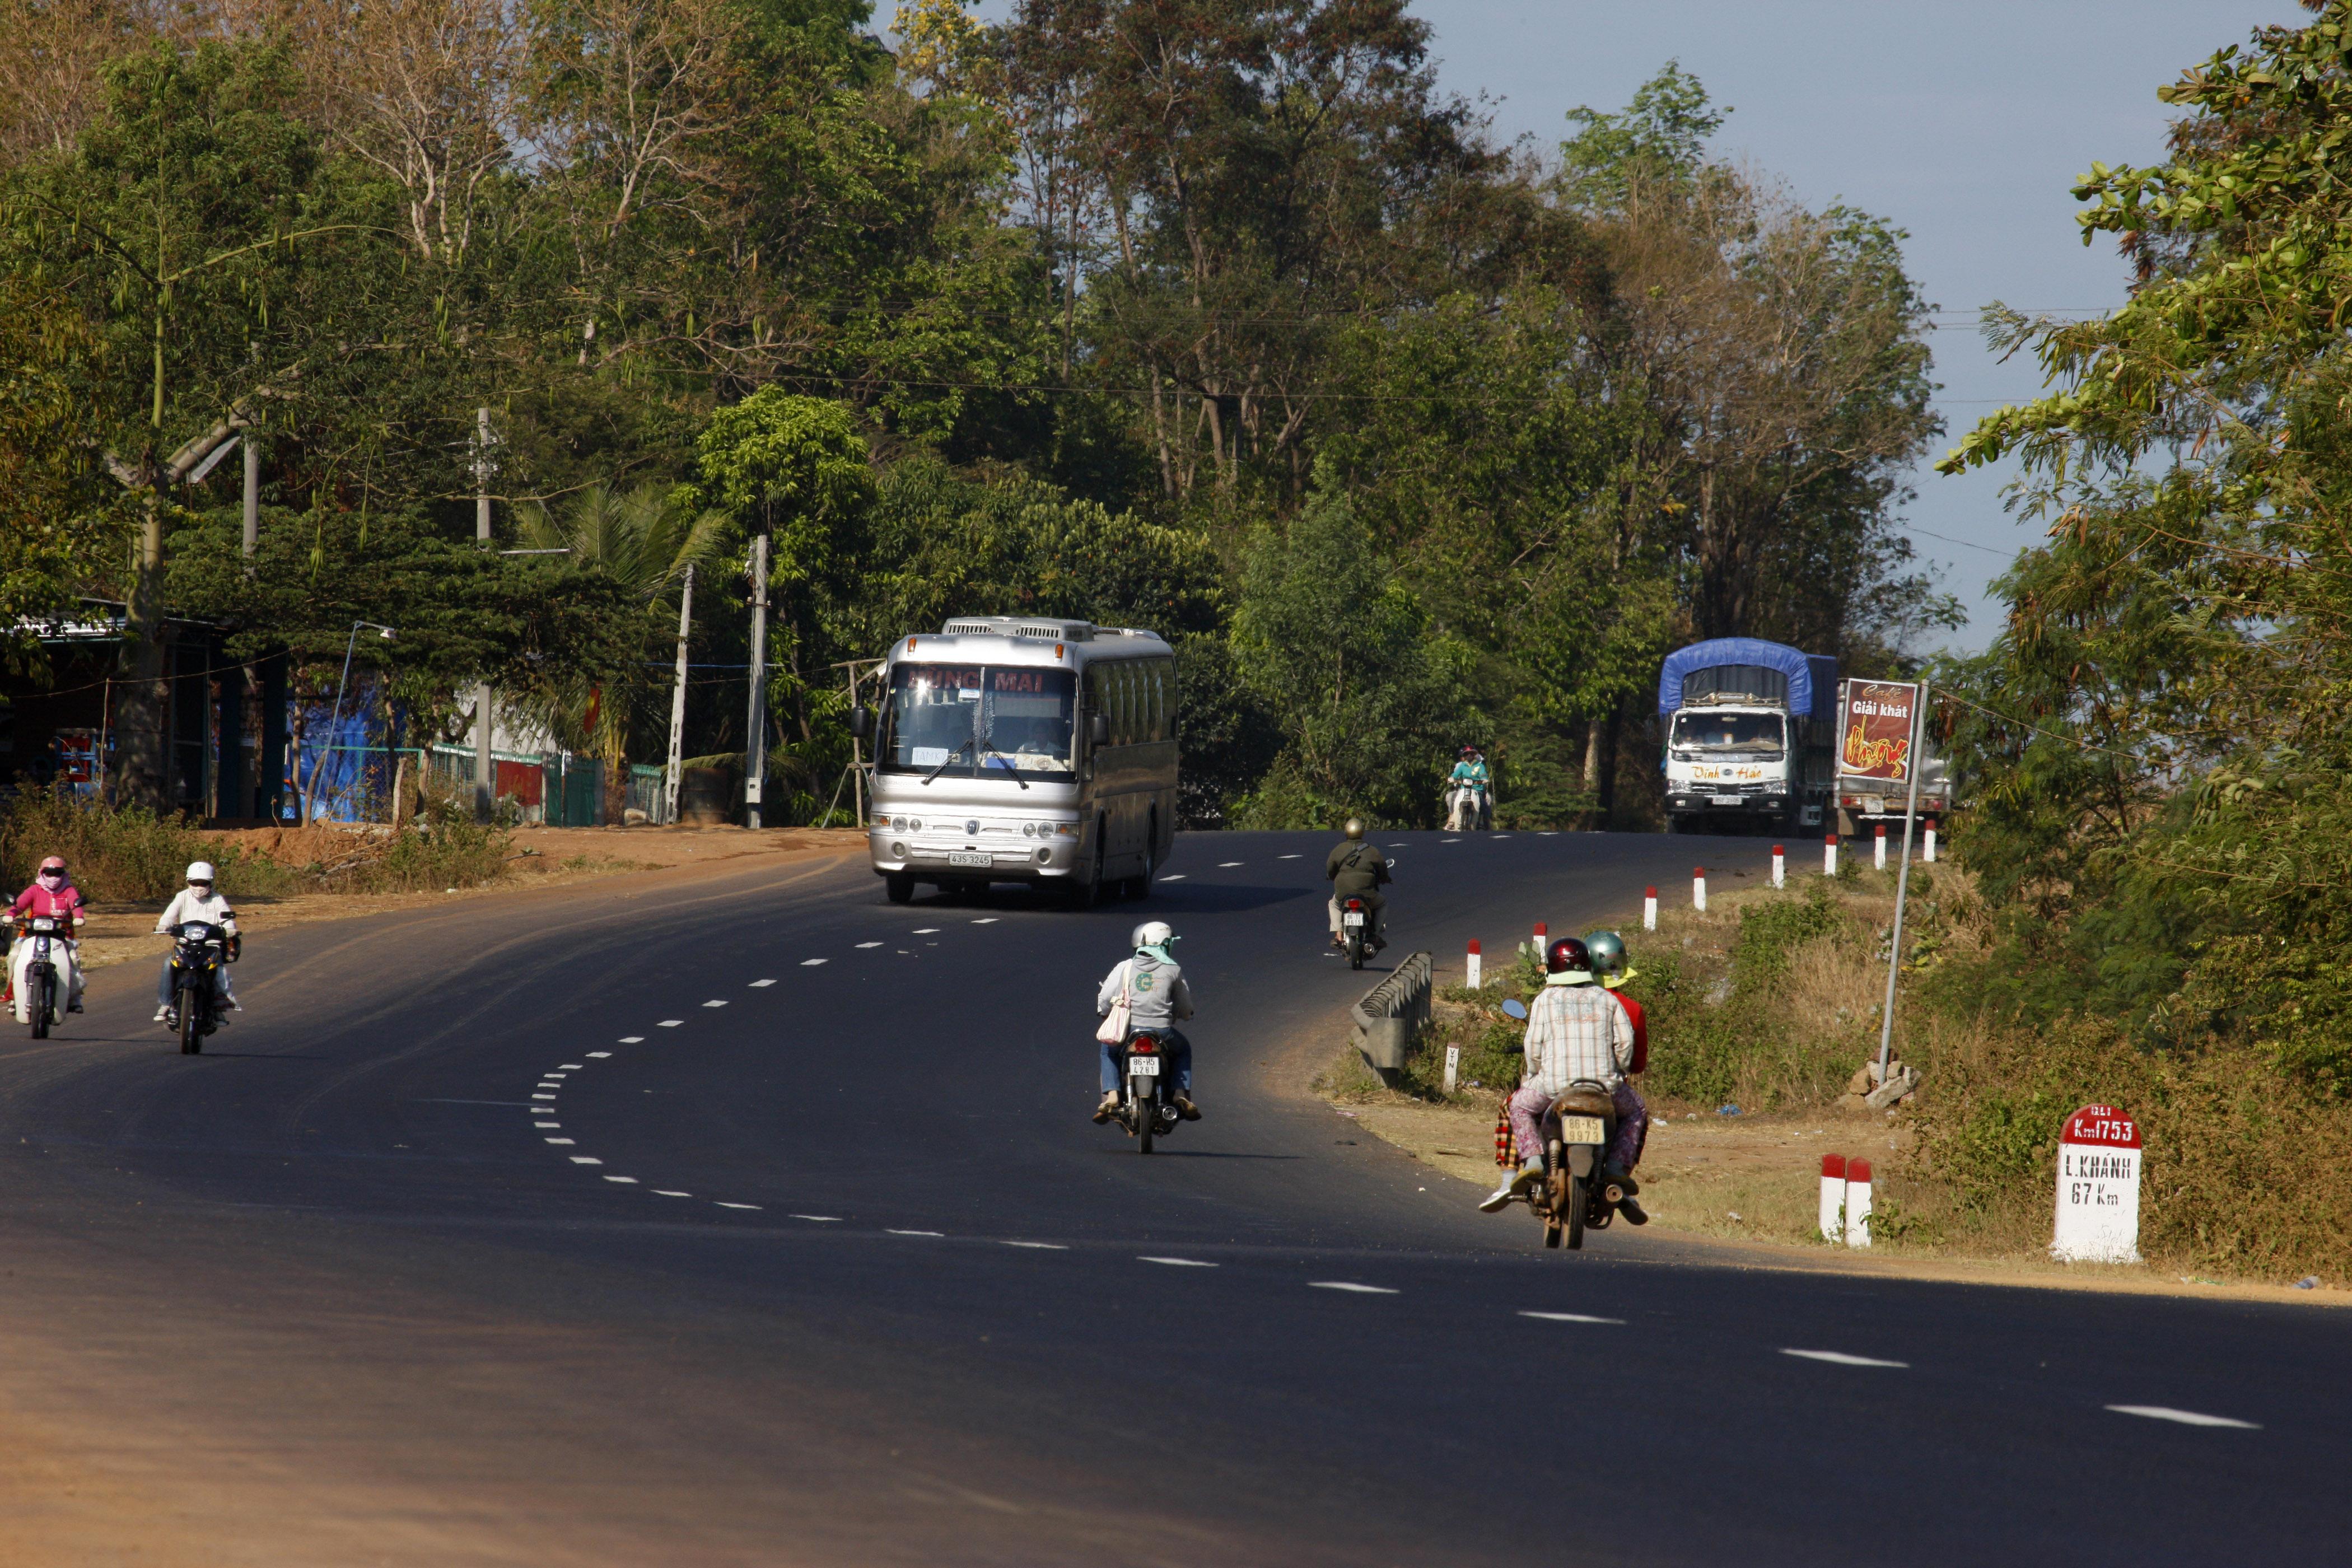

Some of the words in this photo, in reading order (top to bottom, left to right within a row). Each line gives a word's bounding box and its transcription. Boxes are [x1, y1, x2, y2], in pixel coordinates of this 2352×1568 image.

[995, 672, 1043, 692] MAI
[1862, 684, 1902, 700] Café
[1852, 701, 1877, 715] Giải
[1880, 703, 1908, 718] khát
[1570, 1131, 1598, 1142] 9973
[2072, 1183, 2092, 1205] 67
[2097, 1183, 2118, 1205] Km
